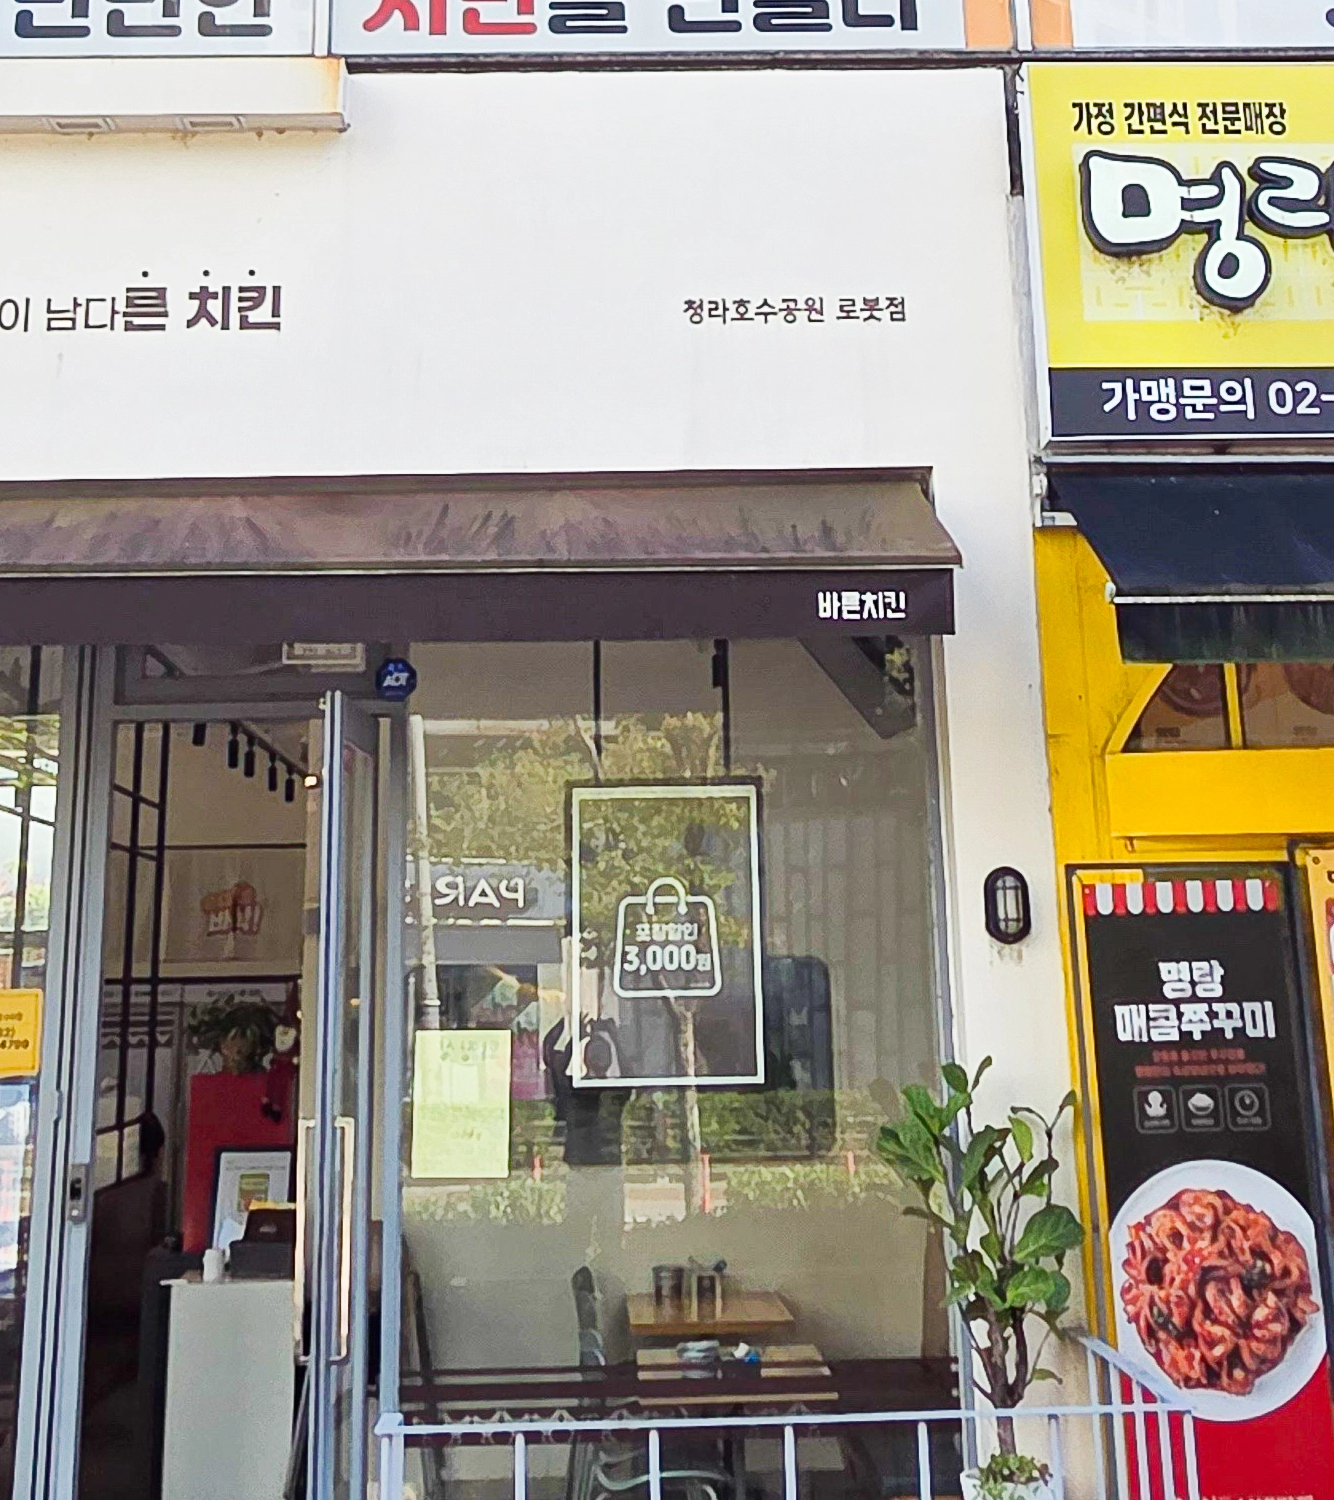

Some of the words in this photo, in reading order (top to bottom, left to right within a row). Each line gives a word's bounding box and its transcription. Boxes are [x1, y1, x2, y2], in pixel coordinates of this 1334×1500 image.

[1071, 100, 1116, 135] 가정
[1123, 100, 1191, 135] 간편식
[1197, 100, 1288, 136] 전문매장
[45, 282, 171, 334] 남다른
[186, 280, 284, 333] 치킨
[682, 296, 826, 325] 청라호수공원
[835, 296, 907, 323] 로봇점
[1101, 377, 1256, 422] 가맹문의
[817, 591, 906, 620] 바른치킨
[1157, 959, 1225, 999] 명랑
